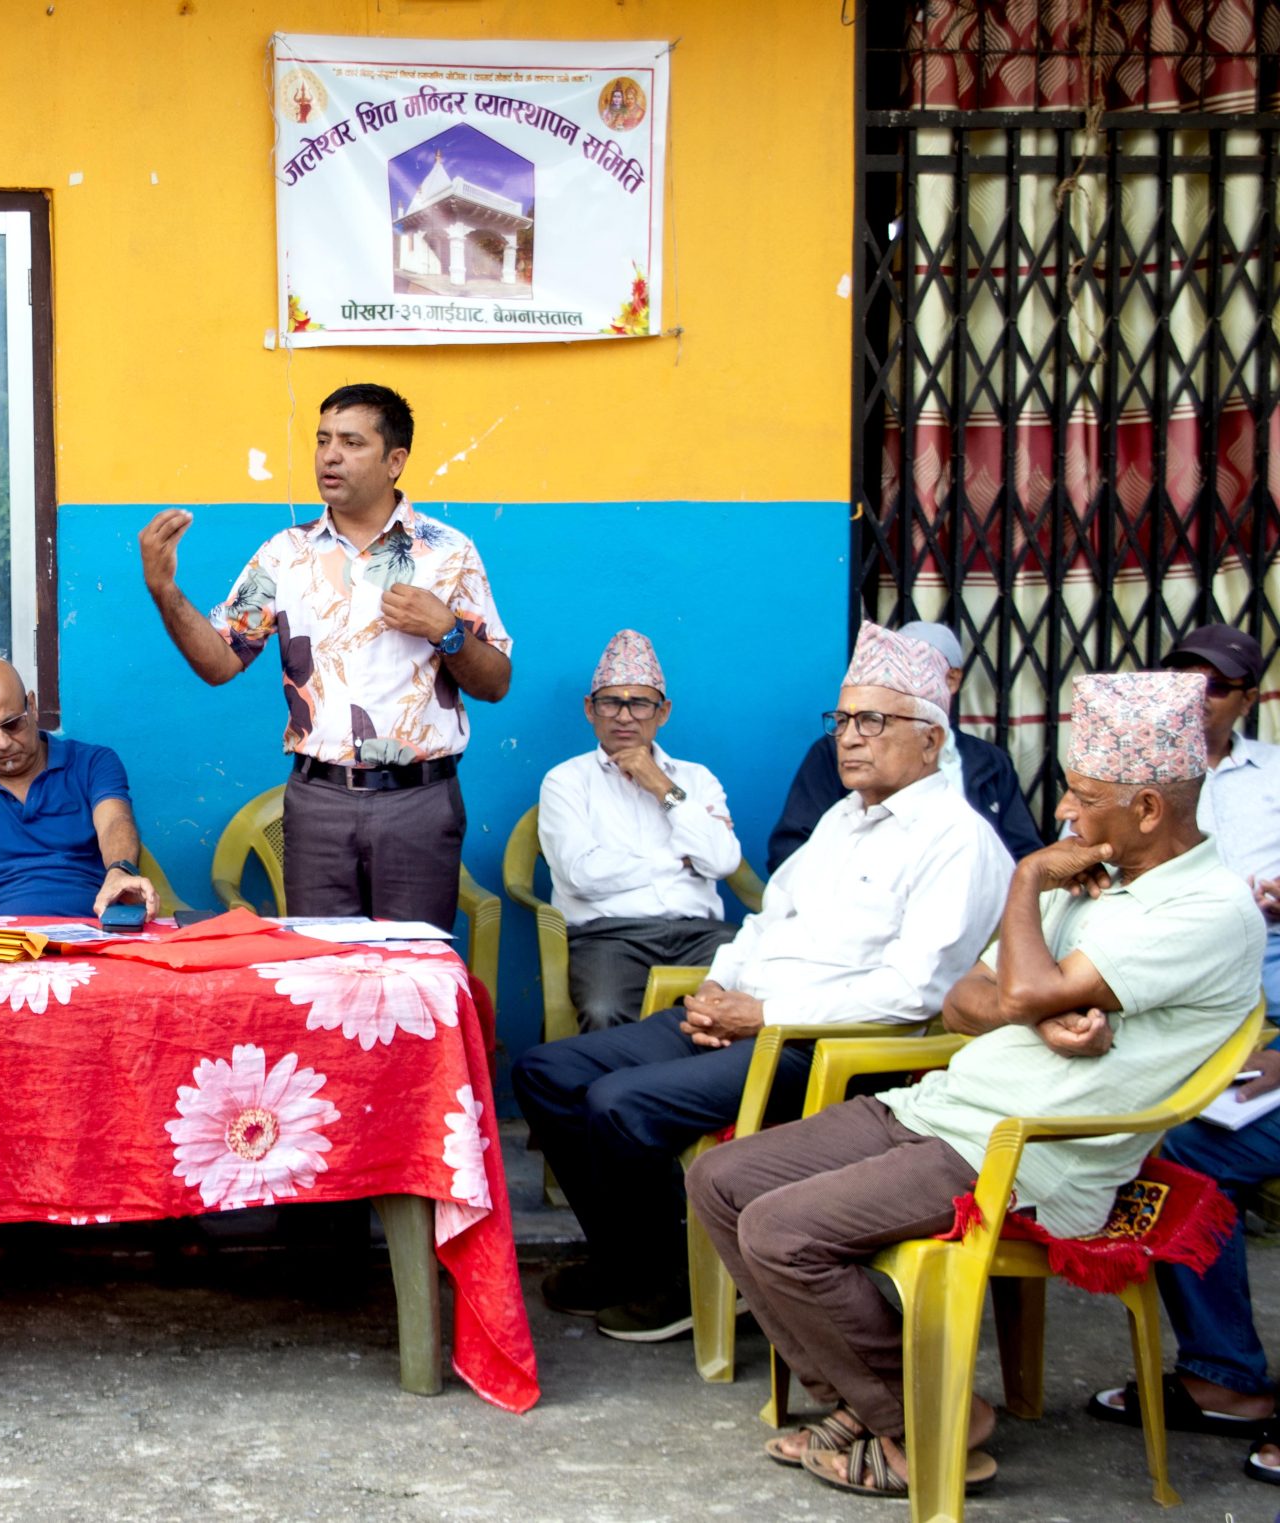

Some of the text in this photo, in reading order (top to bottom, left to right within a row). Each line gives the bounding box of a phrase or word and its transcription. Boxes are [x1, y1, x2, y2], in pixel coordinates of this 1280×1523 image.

[283, 85, 645, 194] जलेश्वर शिव मन्दिर व्यवस्थापन समिति
[493, 304, 584, 326] बेगनासताल
